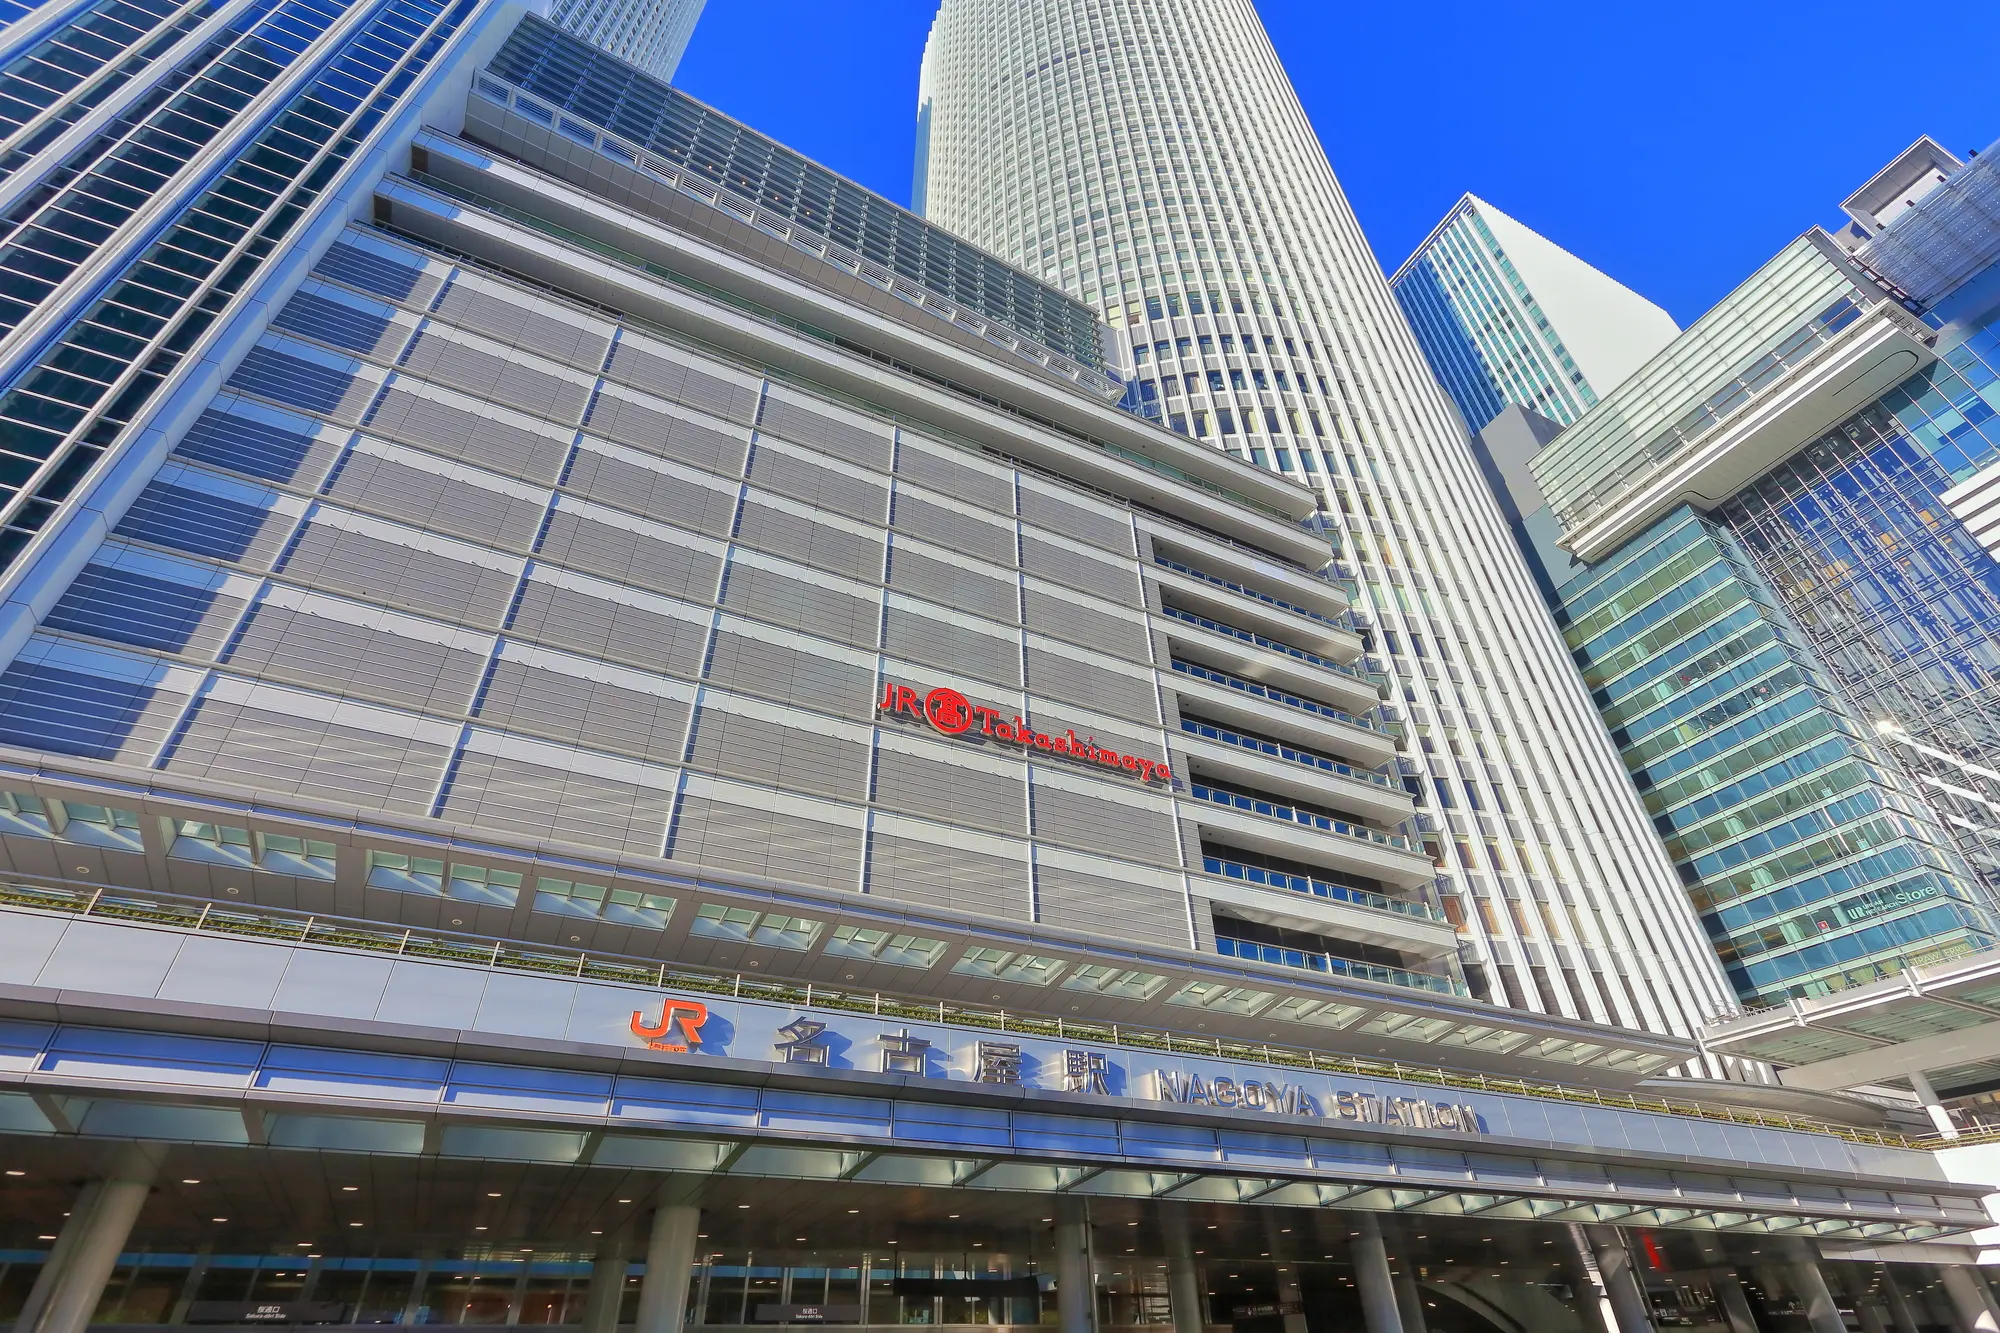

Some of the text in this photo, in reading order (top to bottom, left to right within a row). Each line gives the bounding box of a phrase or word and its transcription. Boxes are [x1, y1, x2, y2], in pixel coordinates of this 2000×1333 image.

[878, 682, 922, 718] JR
[975, 705, 1173, 783] Takashimaya
[1895, 886, 1936, 905] Store
[629, 998, 708, 1044] JR
[774, 1016, 1112, 1096] 名古屋駅
[1154, 1069, 1482, 1133] NAGOYA STATION
